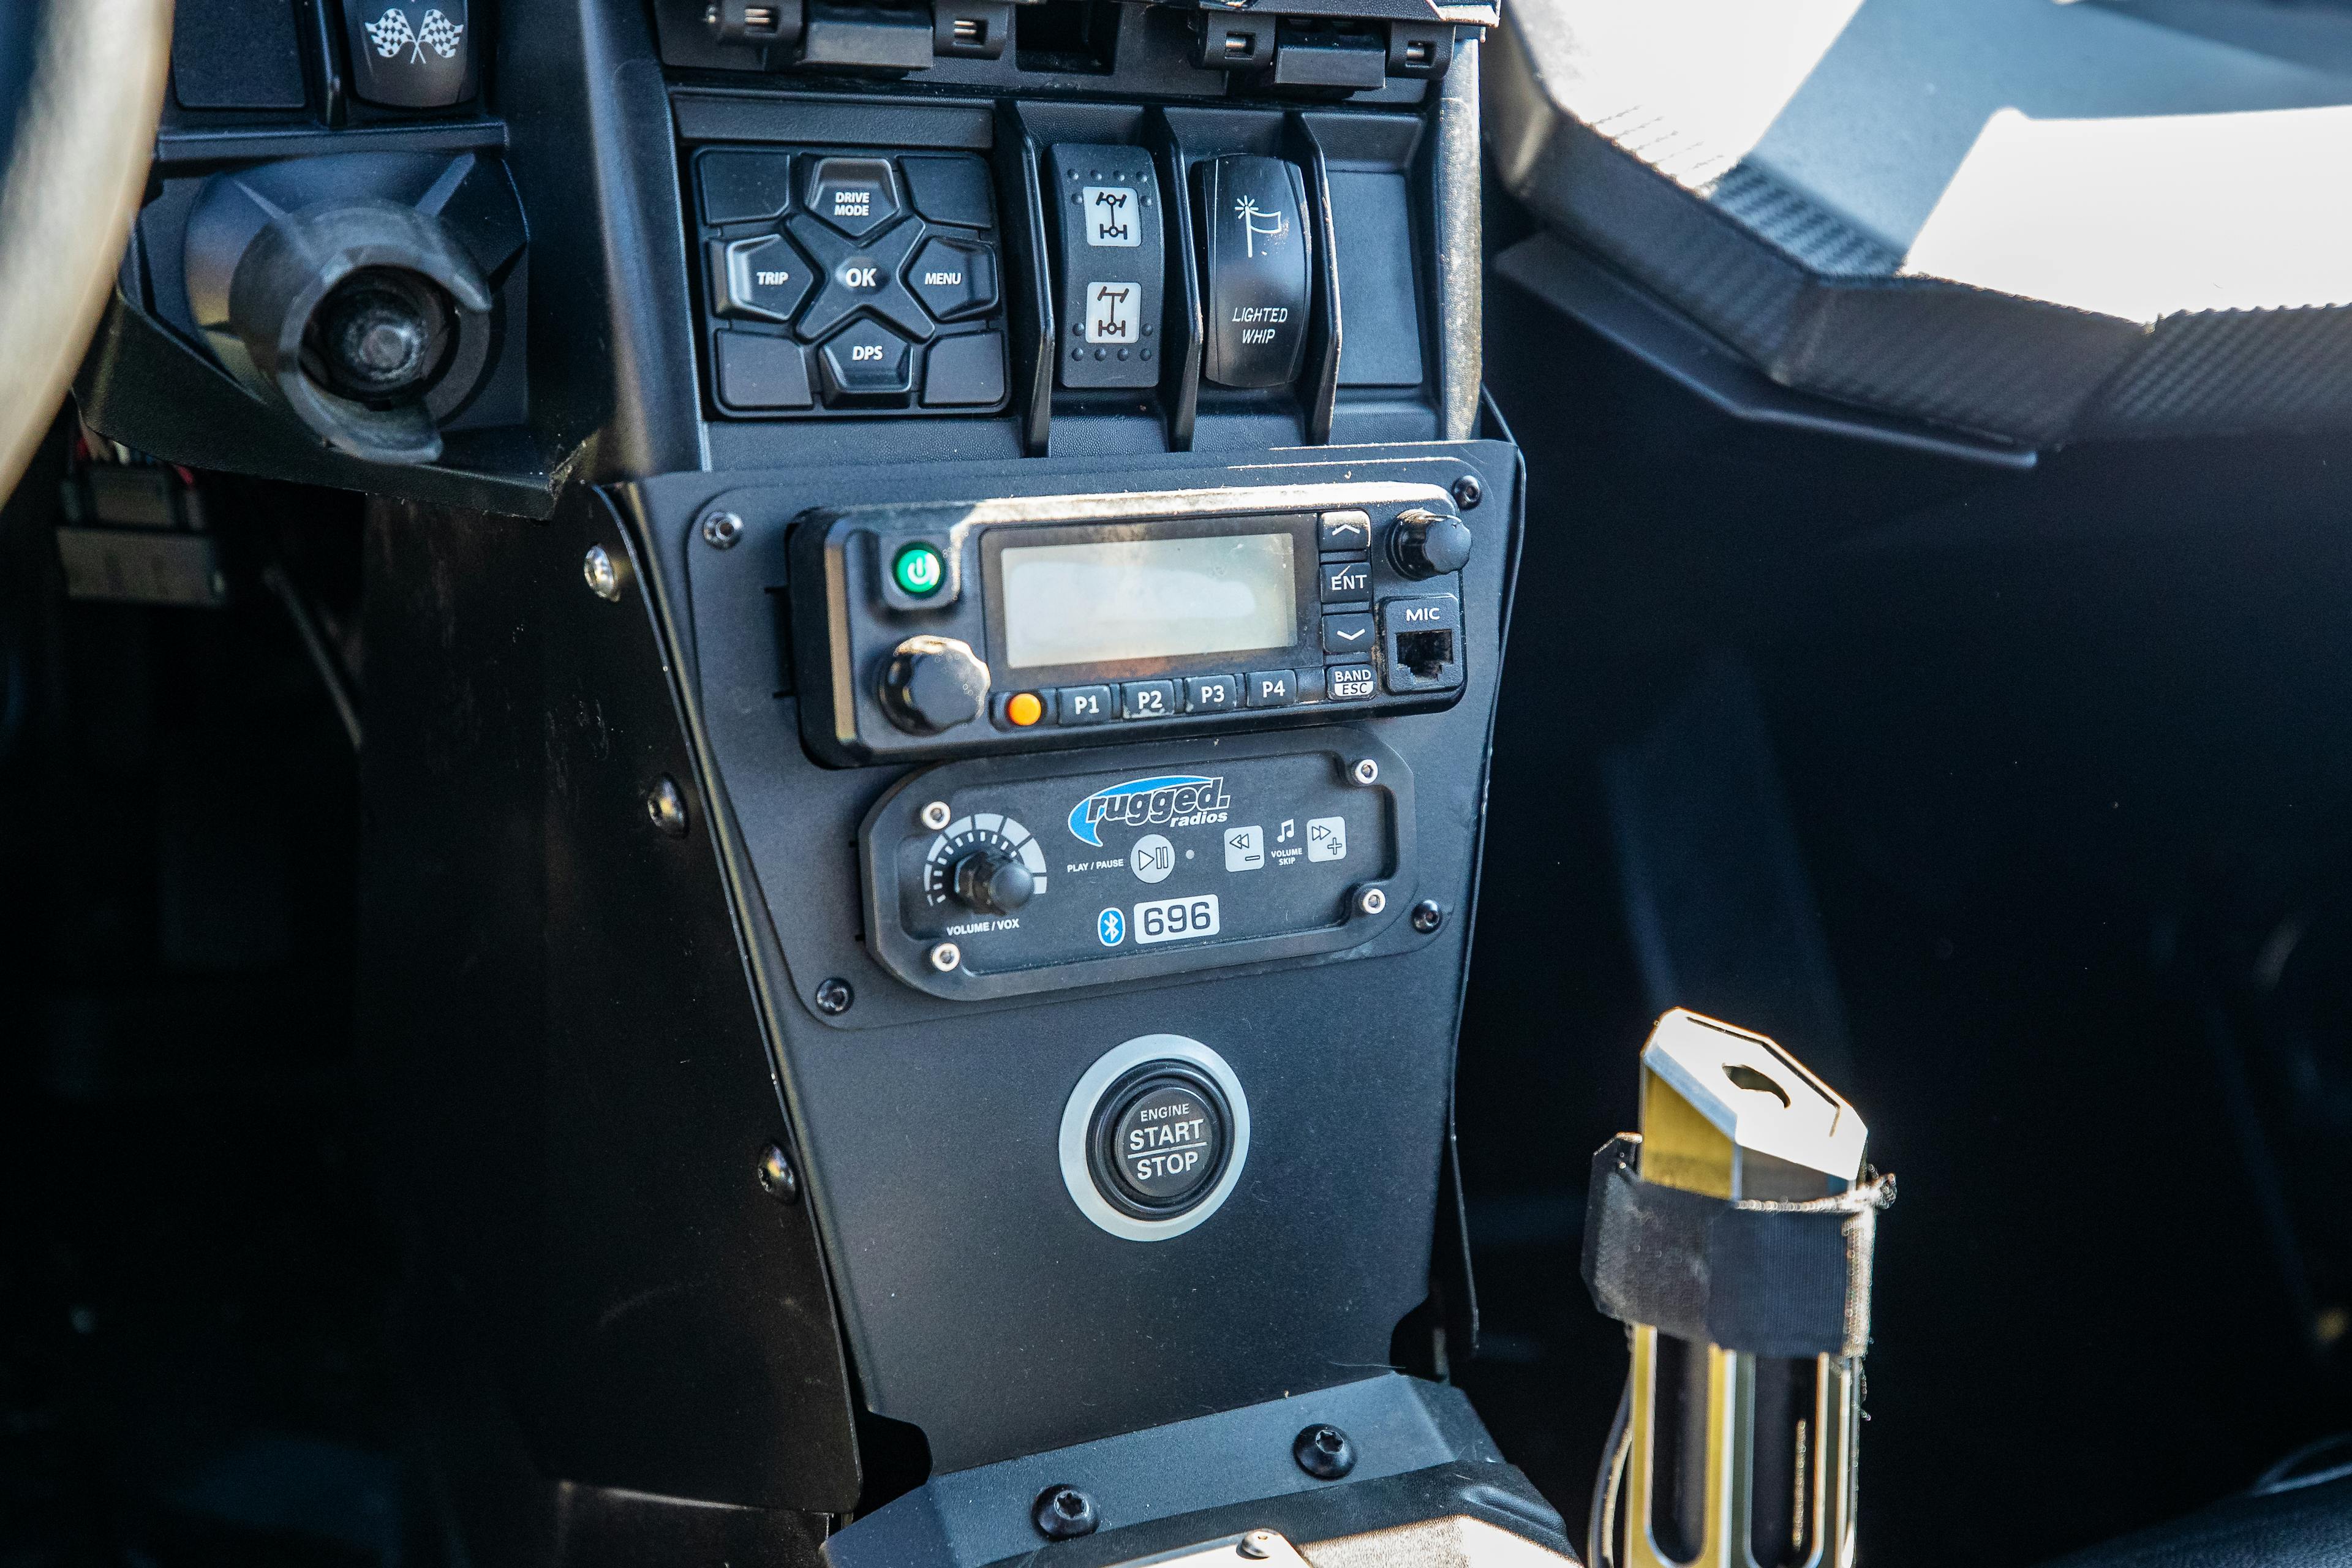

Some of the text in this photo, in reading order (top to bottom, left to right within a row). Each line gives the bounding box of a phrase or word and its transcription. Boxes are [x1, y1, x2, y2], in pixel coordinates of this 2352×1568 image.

[835, 192, 870, 203] DRIVE
[834, 205, 869, 216] MODE
[756, 271, 789, 285] TRIP
[845, 268, 876, 287] OK
[924, 273, 962, 285] MENU
[1232, 307, 1287, 323] LIGHTED
[1242, 329, 1275, 344] WHIP
[852, 345, 883, 360] DPS
[1331, 575, 1367, 591] ENT
[1406, 608, 1441, 621] MIC
[1335, 669, 1371, 682] BAND
[1201, 686, 1225, 704] P3
[1262, 680, 1285, 698] P4
[1342, 682, 1367, 695] ESC
[1074, 695, 1099, 715] P1
[1137, 690, 1163, 709] P2
[1170, 811, 1228, 828] radios
[1271, 847, 1302, 858] VOLUME
[1067, 862, 1088, 873] PLAY
[1096, 858, 1124, 869] PAUSE
[1278, 856, 1296, 866] SKIP
[1143, 901, 1211, 937] 696
[1140, 1103, 1190, 1122] ENGINE
[1129, 1118, 1204, 1151] START
[1137, 1151, 1199, 1180] STOP
